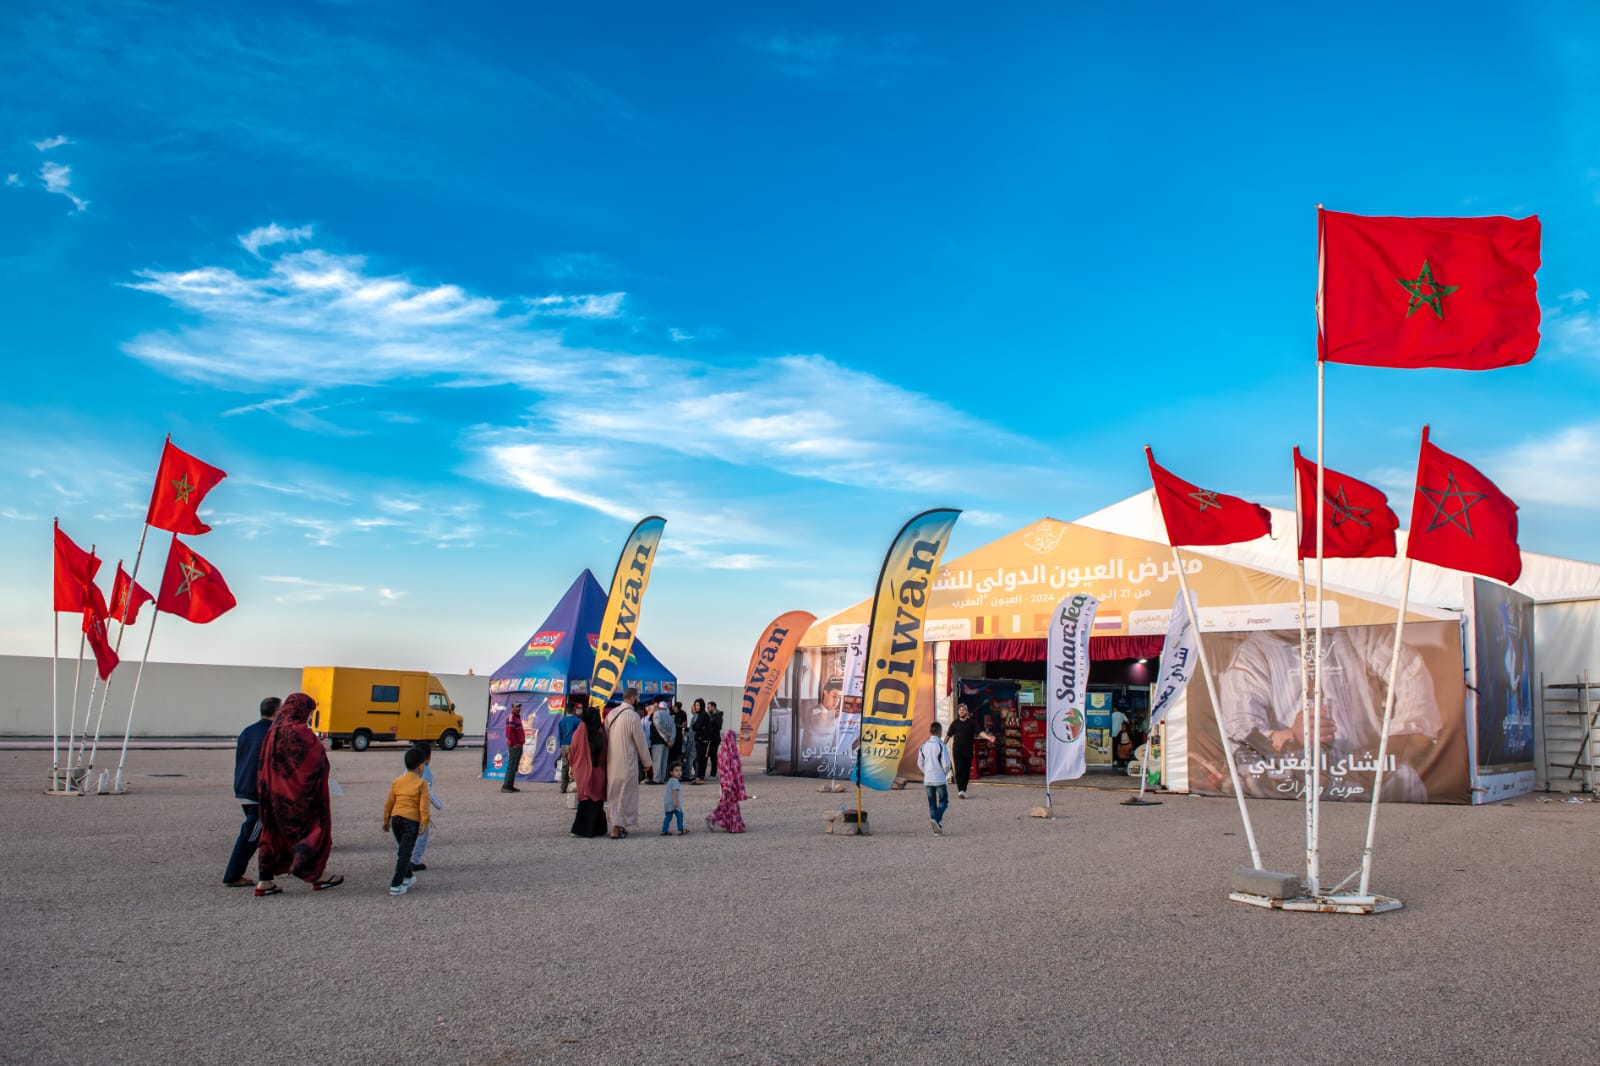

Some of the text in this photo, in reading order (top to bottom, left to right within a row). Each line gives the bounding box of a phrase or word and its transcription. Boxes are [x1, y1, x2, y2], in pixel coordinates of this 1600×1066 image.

[976, 563, 1047, 598] الدولي
[1049, 558, 1124, 588] العيون
[1120, 588, 1131, 600] 21
[1133, 588, 1151, 600] من
[861, 729, 906, 747] ديوان
